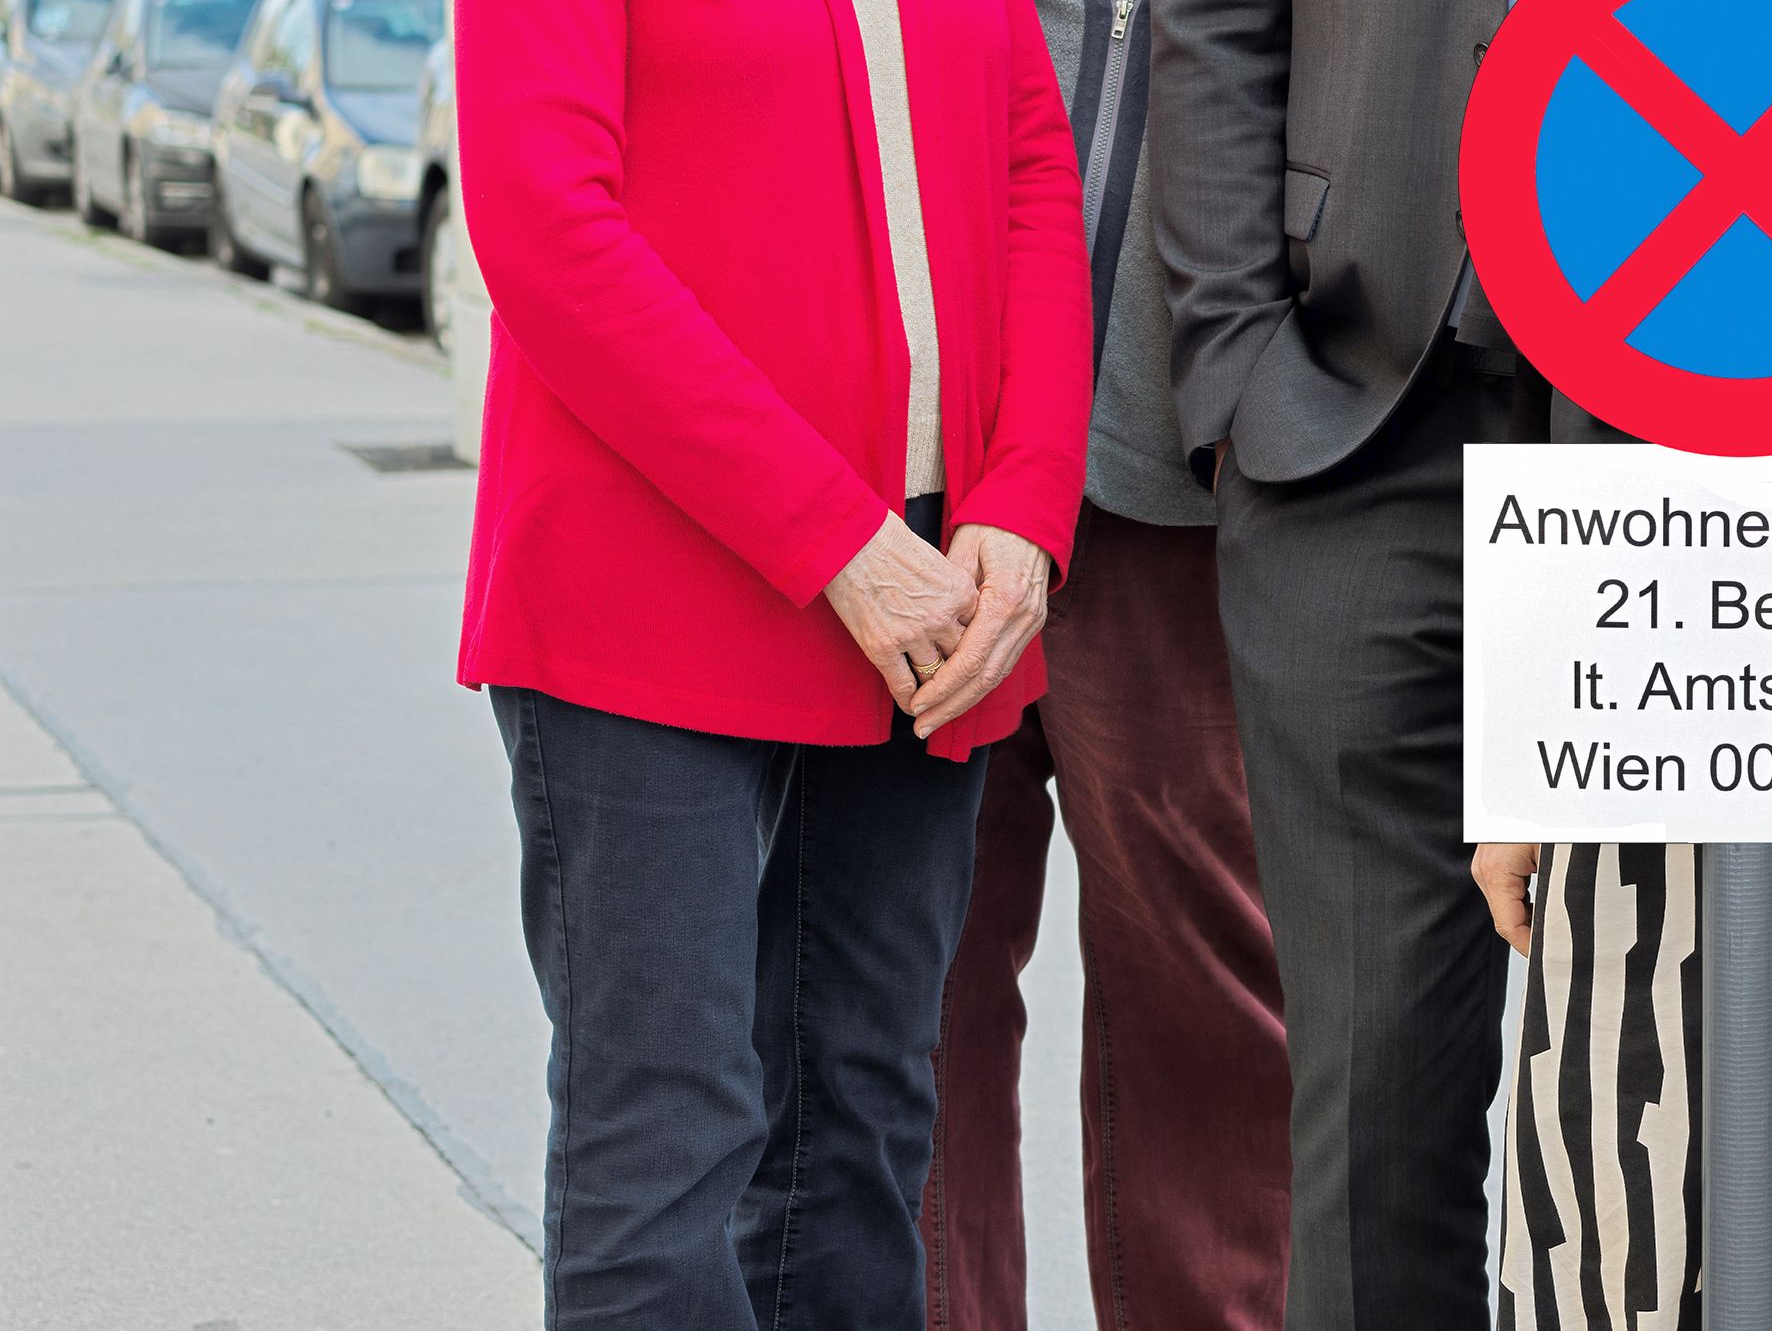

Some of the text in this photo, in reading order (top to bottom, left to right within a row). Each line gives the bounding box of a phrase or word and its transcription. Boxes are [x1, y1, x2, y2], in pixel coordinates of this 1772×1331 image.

[1596, 579, 1683, 629] 21.
[1574, 661, 1617, 709] lt.
[1537, 741, 1685, 791] Wien
